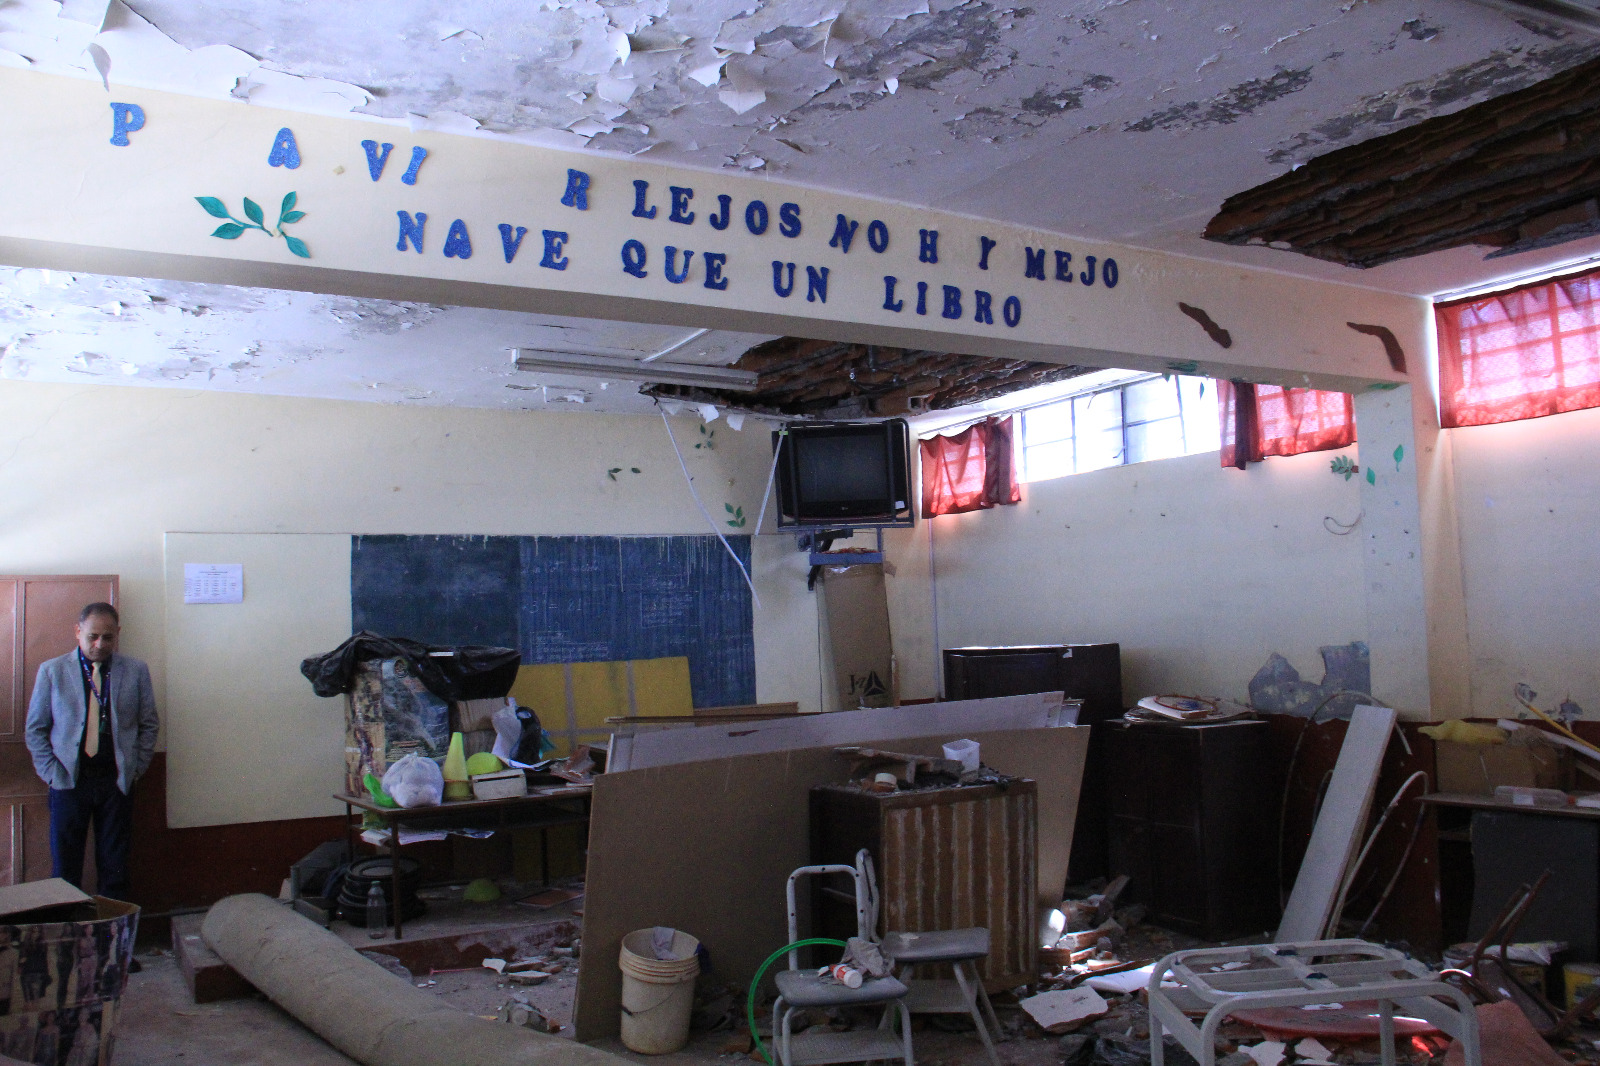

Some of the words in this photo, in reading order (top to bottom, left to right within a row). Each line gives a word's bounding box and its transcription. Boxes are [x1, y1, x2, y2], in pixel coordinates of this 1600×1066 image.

[396, 210, 569, 271] NAVE
[621, 238, 729, 292] QUE
[771, 260, 830, 304] UN
[883, 275, 1023, 328] LIBRO
[631, 179, 802, 239] LEJOS
[829, 213, 890, 255] NO
[1024, 246, 1120, 289] MEJO
